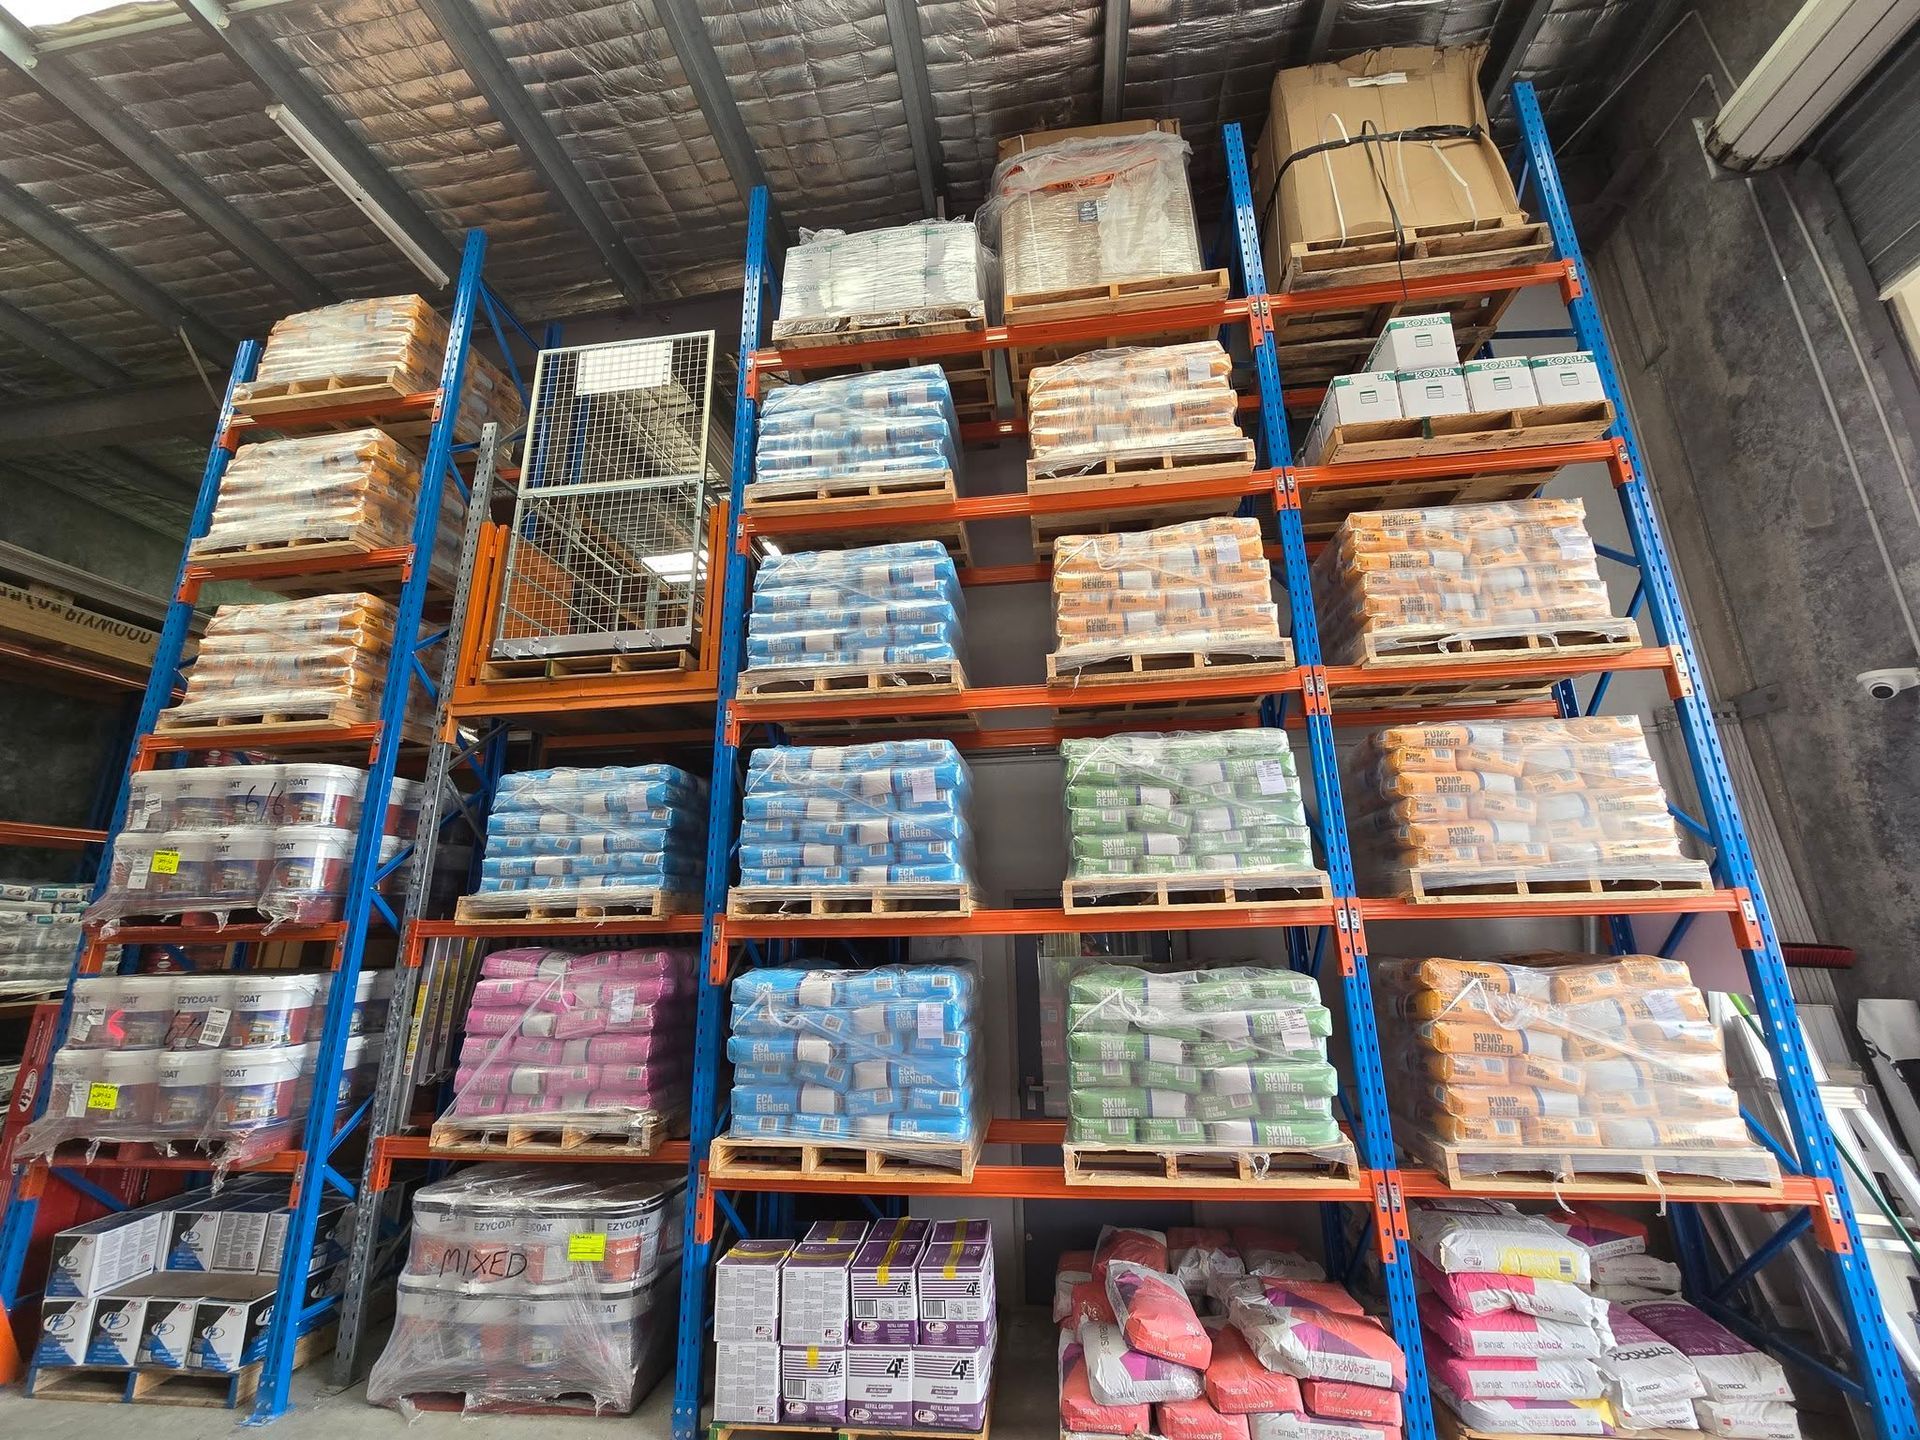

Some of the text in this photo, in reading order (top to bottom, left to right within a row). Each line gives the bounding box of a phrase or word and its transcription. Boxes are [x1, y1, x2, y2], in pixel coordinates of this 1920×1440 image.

[1404, 317, 1446, 328] KOALA
[1480, 360, 1524, 371] KOALA
[1546, 355, 1592, 366] KOALA
[1415, 367, 1458, 379] KOALA
[1389, 560, 1422, 569] RENDER
[1082, 581, 1112, 590] RENDER
[1086, 624, 1117, 633] RENDER
[1424, 730, 1451, 738] PUMP
[1425, 738, 1461, 747] RENDER
[289, 778, 309, 787] COAT
[1435, 776, 1462, 785] PUMP
[1096, 789, 1118, 798] SKIM
[1436, 784, 1471, 793] RENDER
[244, 781, 286, 823] 6/6
[1096, 797, 1130, 807] RENDER
[1241, 807, 1265, 818] SKIM
[900, 829, 932, 839] RENDER
[1447, 826, 1475, 836] PUMP
[1102, 838, 1125, 848] SKIM
[1449, 835, 1485, 845] RENDER
[277, 842, 296, 851] COAT
[763, 849, 779, 858] ECA
[1103, 847, 1137, 857] RENDER
[763, 857, 794, 866] RENDER
[1248, 855, 1272, 865] SKIM
[898, 868, 914, 876] ECA
[177, 995, 220, 1005] EZYCOAT
[240, 995, 261, 1004] COAT
[895, 1011, 912, 1020] ECA
[1260, 1014, 1276, 1025] SKI
[1262, 1024, 1280, 1034] REN
[1473, 1032, 1503, 1043] PUMP
[1100, 1040, 1125, 1051] SKIM
[1474, 1043, 1514, 1054] RENDER
[752, 1052, 786, 1062] RENDER
[1101, 1050, 1137, 1060] RENDER
[161, 1069, 181, 1079] COAT
[225, 1069, 248, 1078] COAT
[1263, 1072, 1290, 1083] SKIM
[899, 1074, 933, 1085] RENDER
[1265, 1082, 1304, 1092] RENDER
[756, 1094, 773, 1104] ECA
[1102, 1098, 1128, 1109] SKIM
[1487, 1096, 1518, 1107] PUMP
[756, 1103, 790, 1113] RENDER
[1103, 1108, 1140, 1117] RENDER
[1489, 1106, 1530, 1117] RENDER
[900, 1120, 918, 1131] ECA
[1265, 1125, 1293, 1137] SKIM
[1267, 1136, 1307, 1147] RENDER
[474, 1219, 516, 1232] EZYCOAT
[530, 1222, 554, 1233] COAT
[606, 1217, 650, 1232] EZYCOAT
[438, 1248, 528, 1279] MIXED
[1483, 1341, 1505, 1350] siniat
[1512, 1341, 1563, 1350] mastablock
[1607, 1346, 1674, 1362] GYPROCK
[1481, 1380, 1562, 1390] siniat mastablock
[1636, 1383, 1662, 1393] GYPROCK
[1323, 1405, 1372, 1418] mastacove75
[1498, 1419, 1519, 1428] siniat
[1527, 1418, 1577, 1428] mastabond
[1276, 1427, 1300, 1438] siniat
